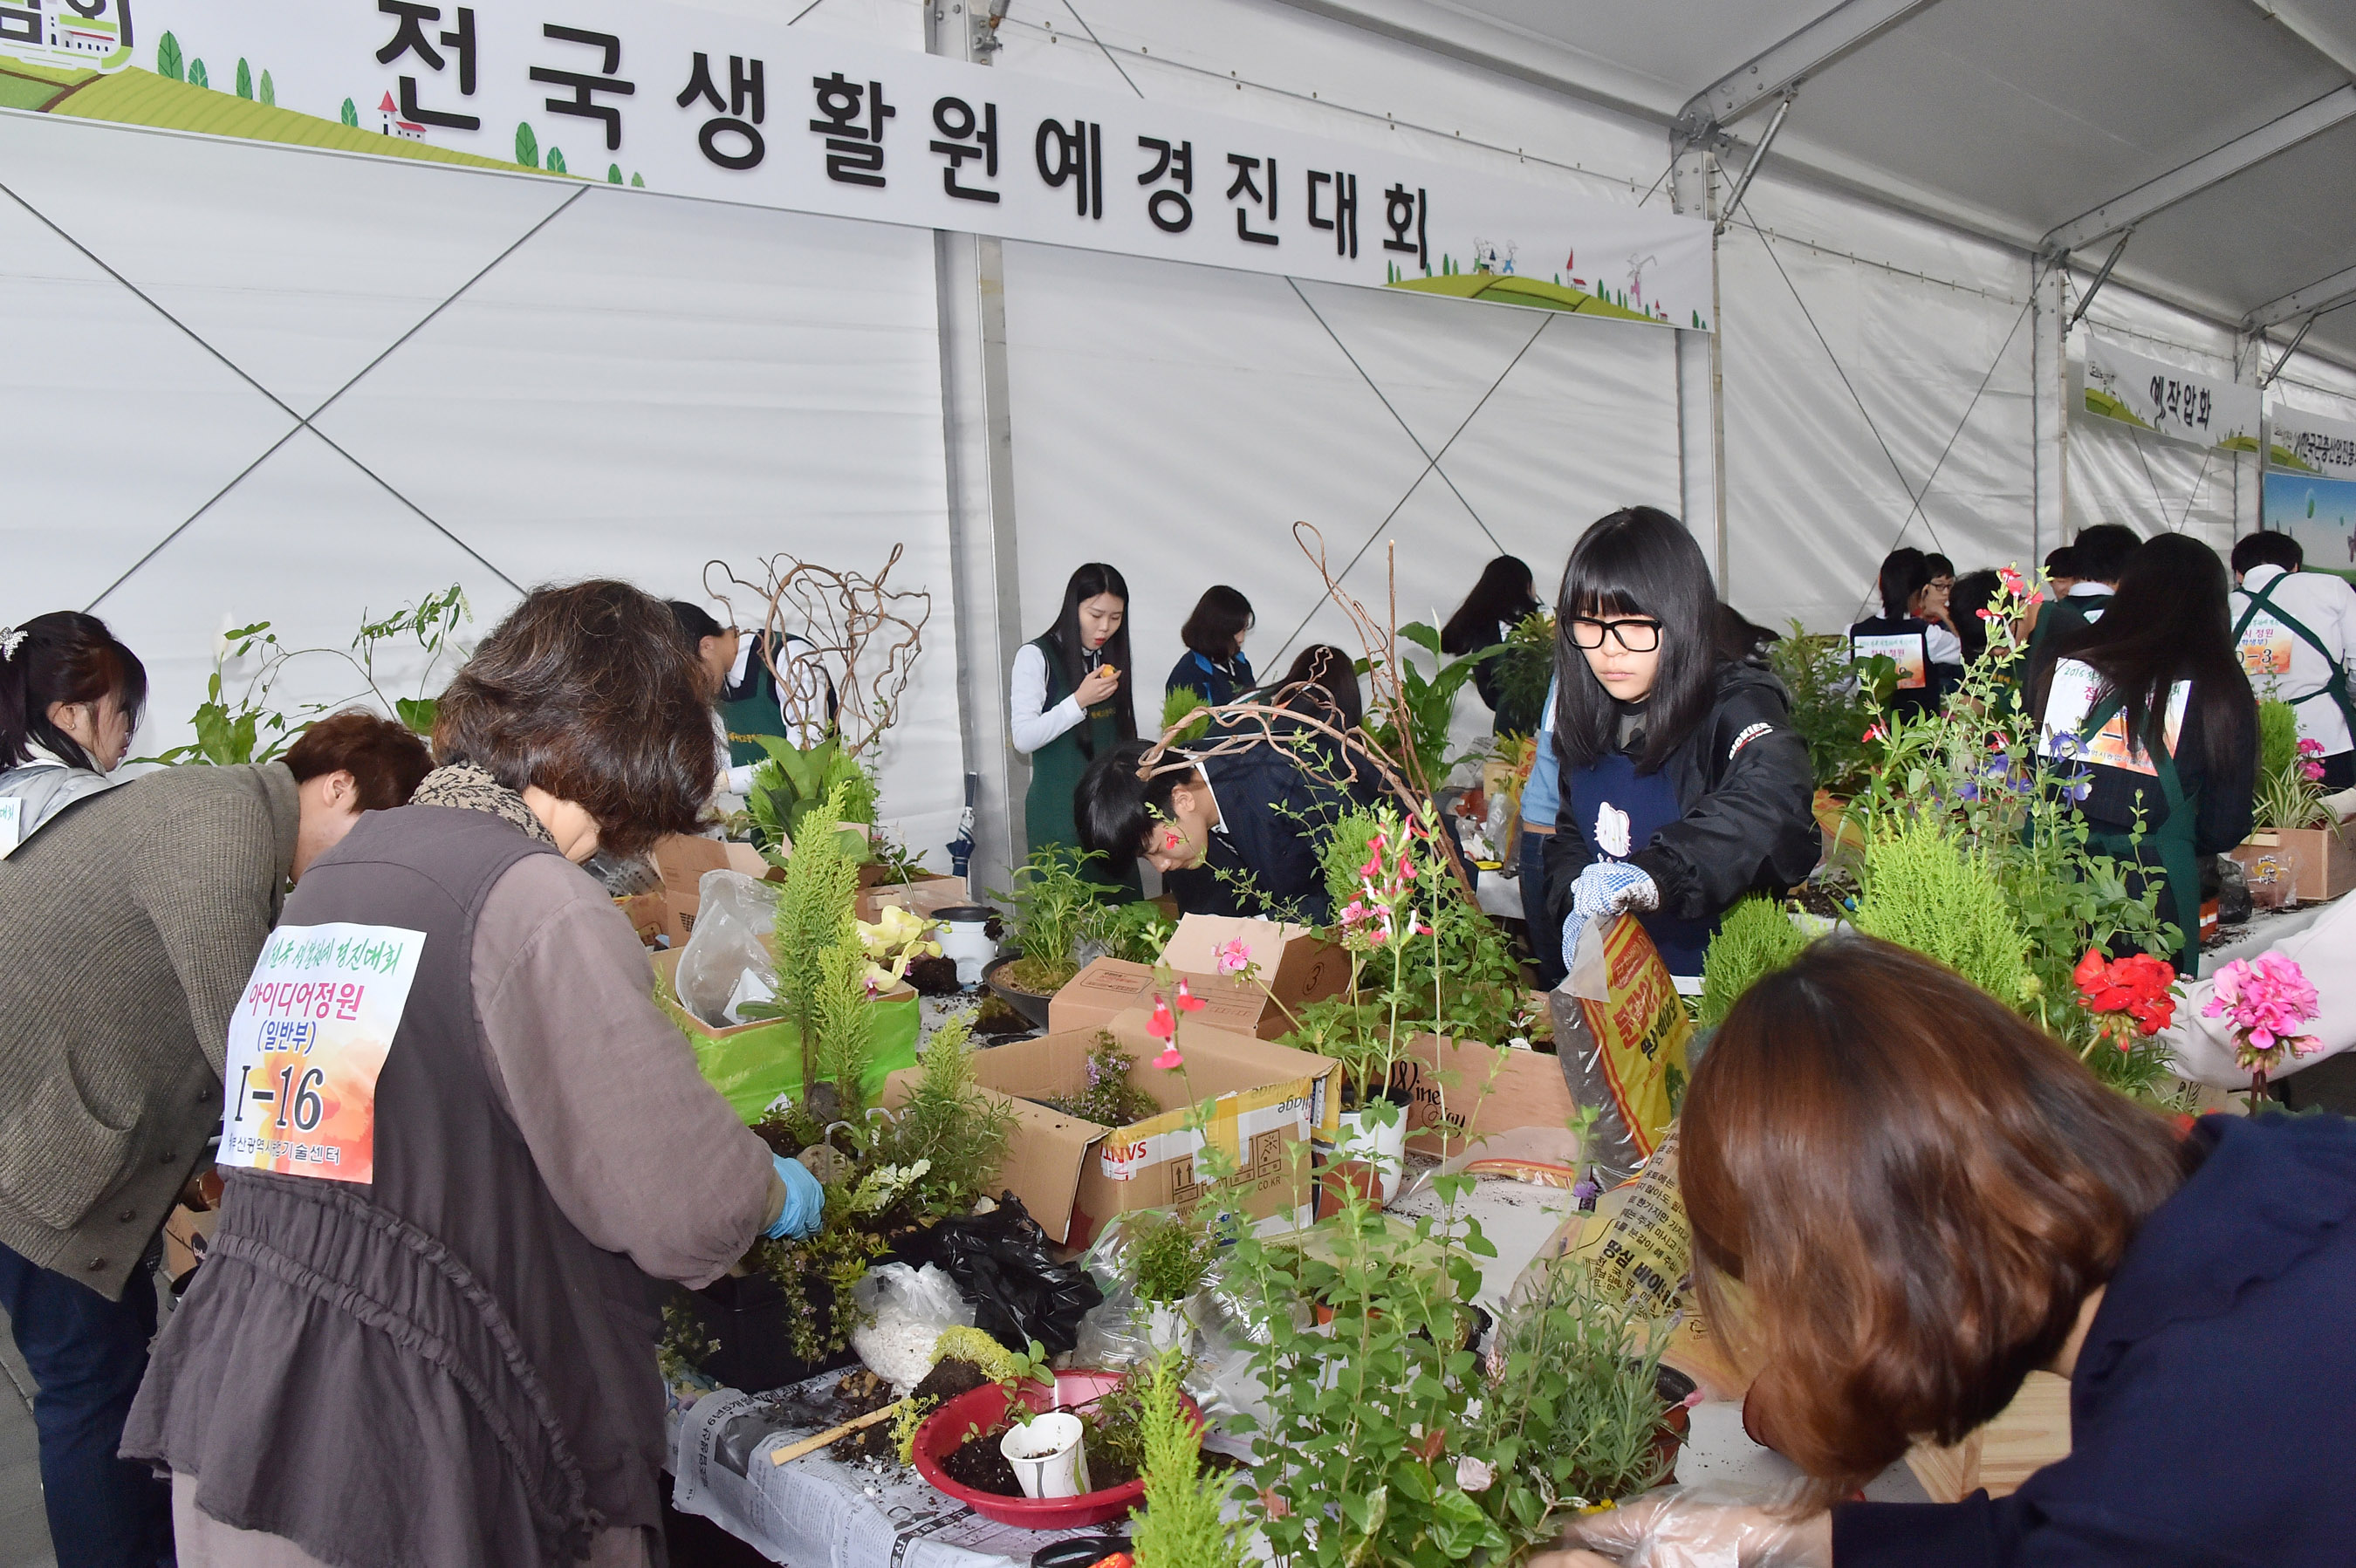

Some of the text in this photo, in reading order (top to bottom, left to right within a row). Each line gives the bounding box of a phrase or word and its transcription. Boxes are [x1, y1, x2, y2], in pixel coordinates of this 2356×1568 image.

[249, 982, 365, 1021] 아이디어정원
[257, 1019, 317, 1055] (일반부)
[1603, 1239, 1635, 1270] 땅심
